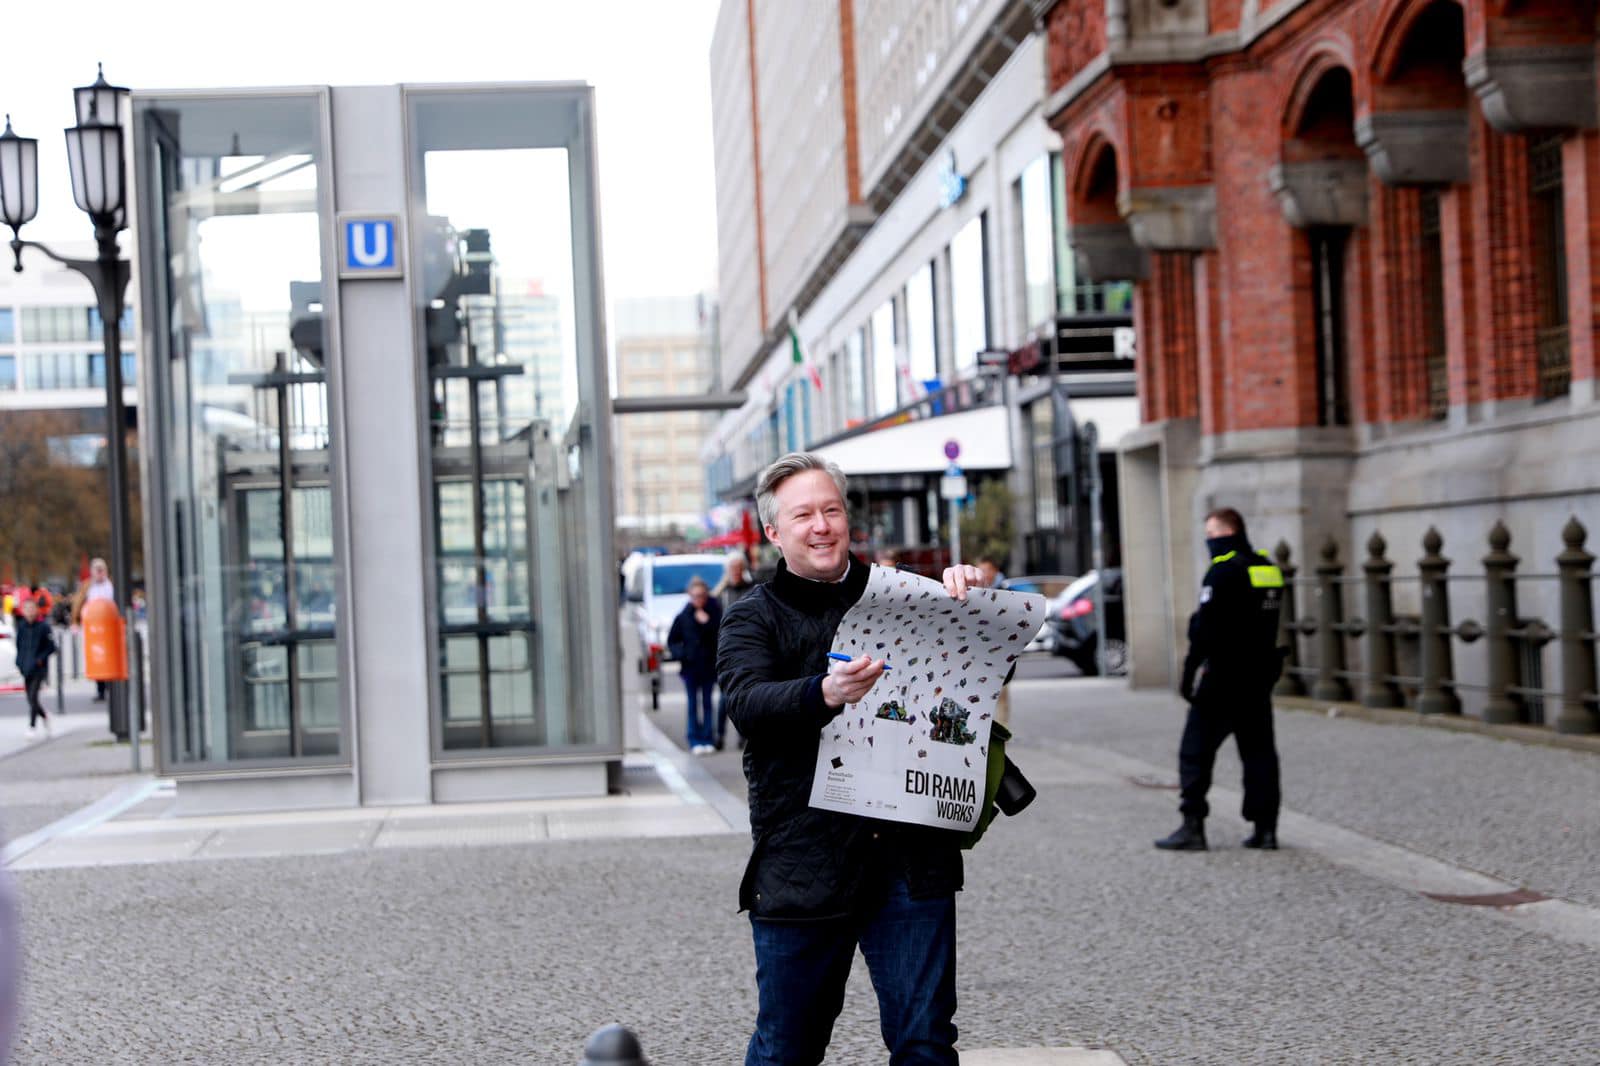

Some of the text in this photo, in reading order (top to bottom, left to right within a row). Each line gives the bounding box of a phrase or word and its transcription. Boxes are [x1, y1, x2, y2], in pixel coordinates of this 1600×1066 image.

[353, 222, 388, 265] U
[905, 768, 976, 805] EDI RAMA
[936, 799, 975, 824] WORKS
